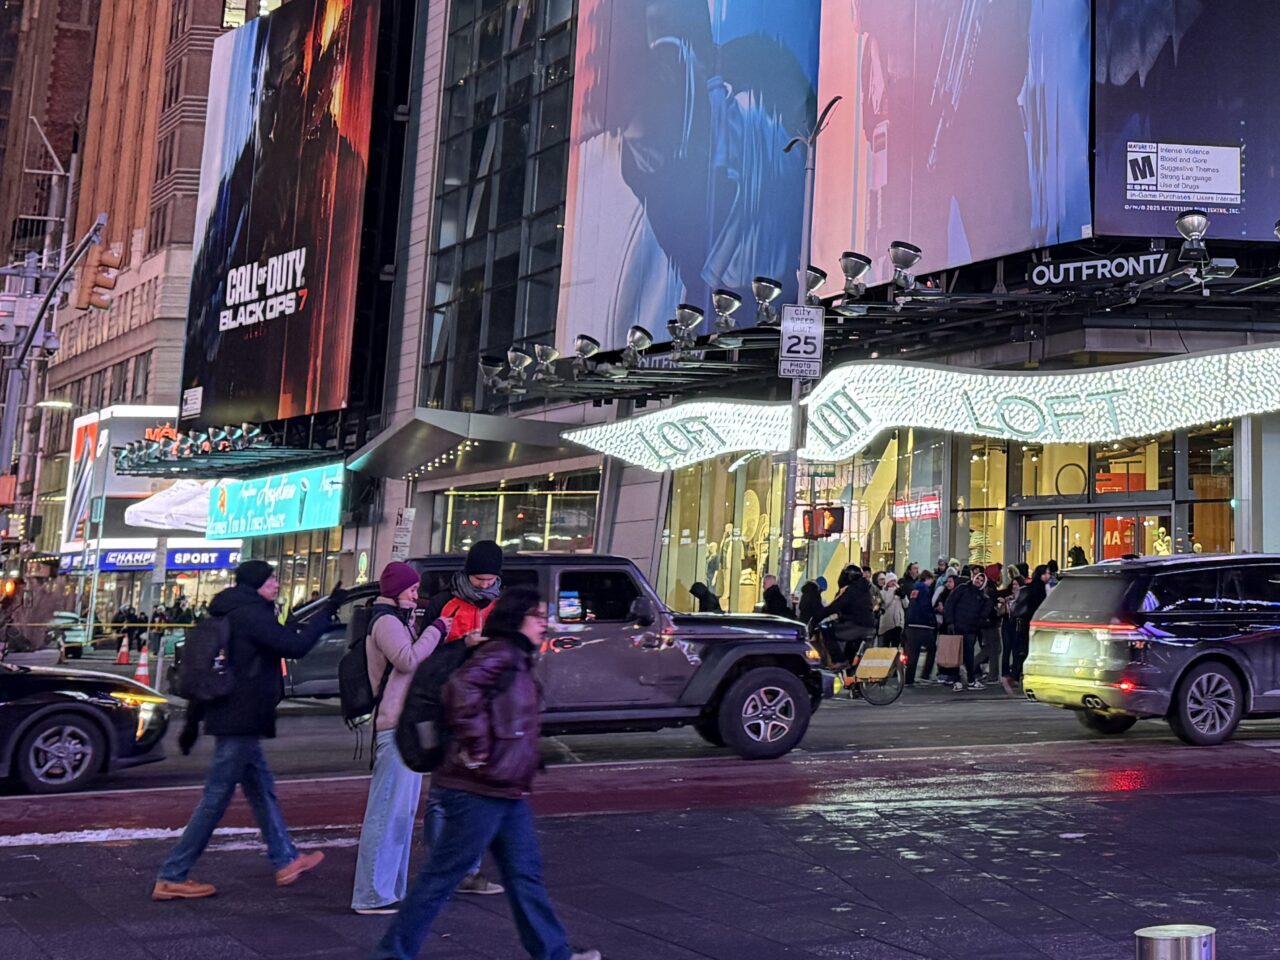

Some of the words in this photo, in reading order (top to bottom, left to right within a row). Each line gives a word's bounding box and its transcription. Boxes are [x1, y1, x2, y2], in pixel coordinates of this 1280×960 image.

[1160, 146, 1183, 154] Intense
[1184, 147, 1210, 156] Violence
[1160, 155, 1178, 163] Blood
[1179, 156, 1191, 164] and
[1192, 157, 1208, 165] Gore
[1129, 155, 1155, 181] M
[1160, 163, 1194, 173] Suggestive
[1195, 165, 1219, 173] Themes
[1160, 172, 1181, 181] Strong
[1181, 174, 1212, 183] Language
[1173, 182, 1181, 190] of
[1182, 183, 1200, 191] Drugs
[1158, 192, 1192, 201] Purchases
[1196, 195, 1215, 203] Users
[1215, 196, 1239, 204] Interact
[1161, 205, 1193, 213] ACTIVISION
[226, 261, 259, 307] CALL
[257, 266, 267, 285] OF
[265, 247, 307, 297] DUTY
[219, 300, 264, 332] BLACK
[265, 291, 297, 321] OPS
[298, 288, 308, 311] 7
[794, 308, 811, 316] CITY
[790, 317, 815, 325] SPEED
[786, 335, 817, 355] 25
[782, 368, 818, 376] ENFORCED
[960, 387, 1128, 438] LOFT
[806, 385, 873, 452] LOFT
[637, 414, 727, 464] LOFT
[174, 552, 218, 564] SPORT
